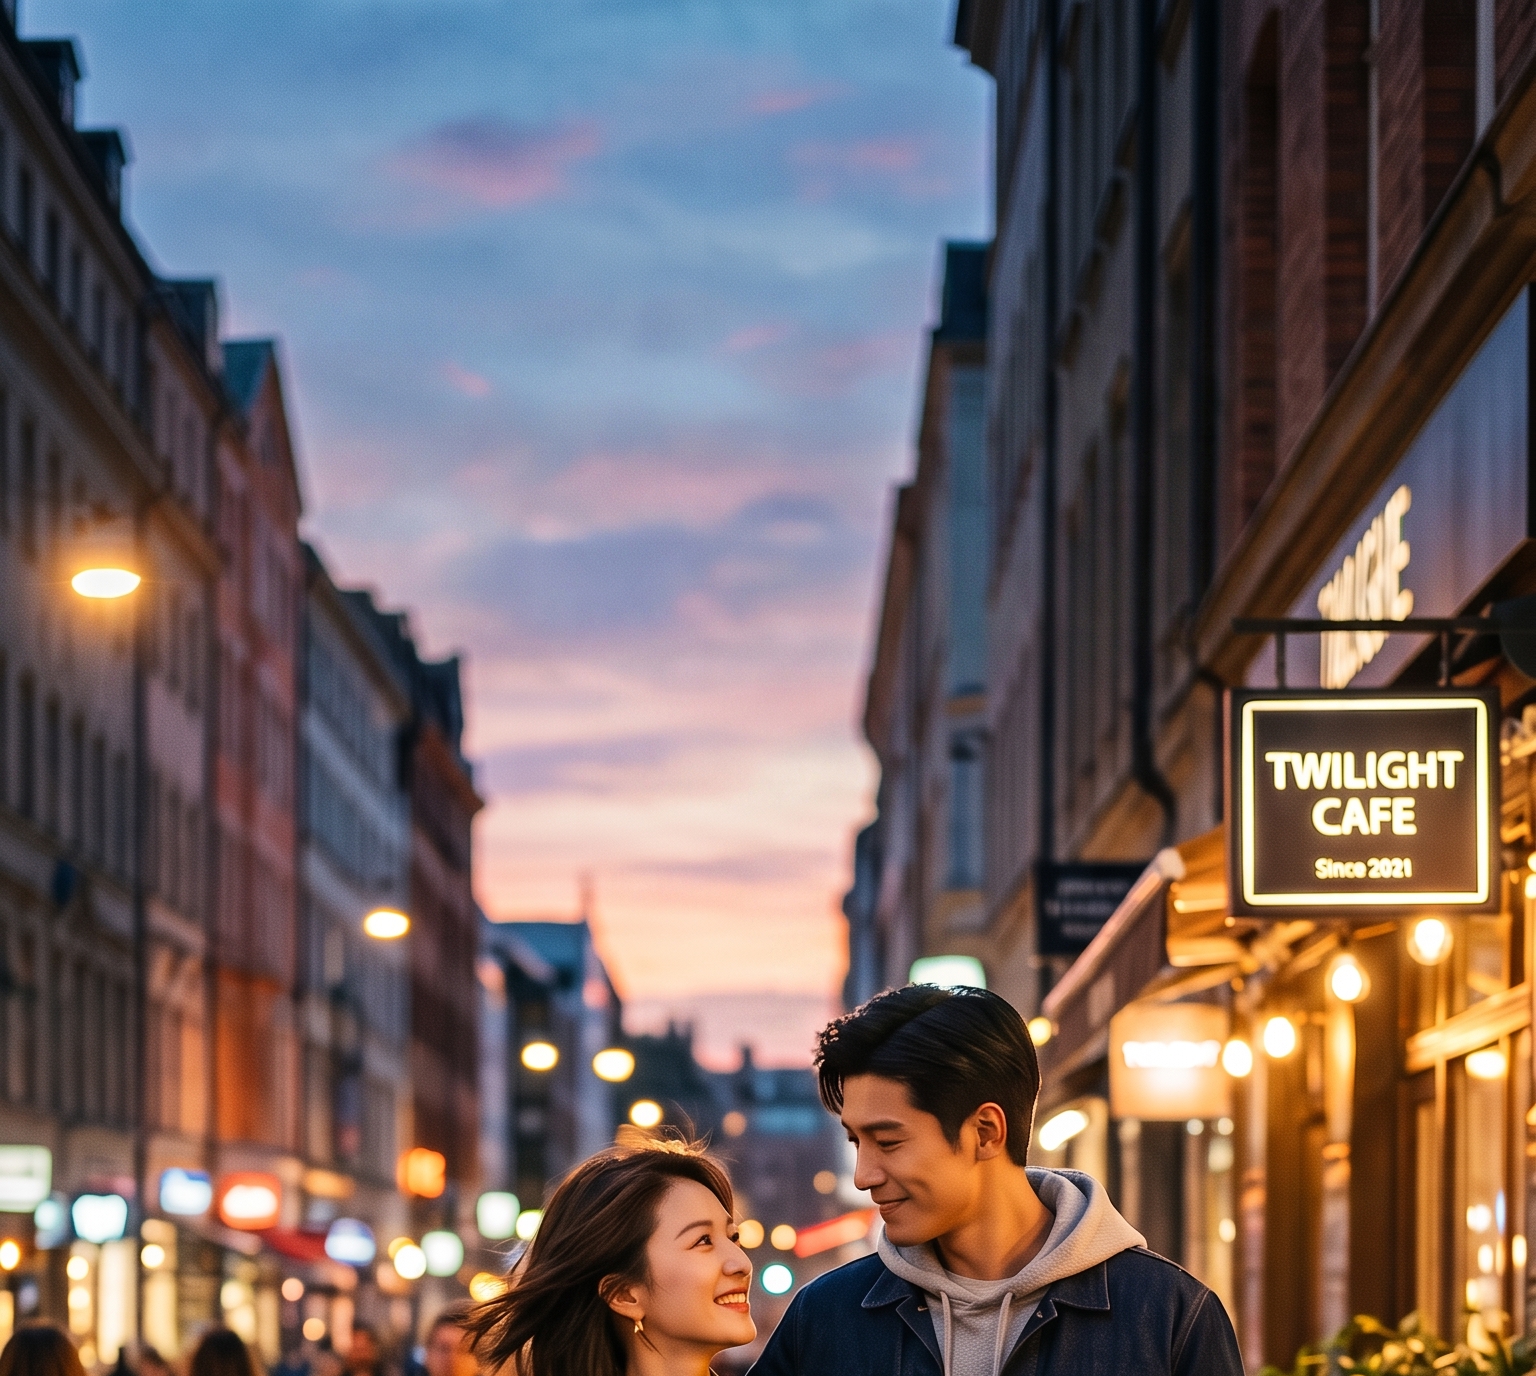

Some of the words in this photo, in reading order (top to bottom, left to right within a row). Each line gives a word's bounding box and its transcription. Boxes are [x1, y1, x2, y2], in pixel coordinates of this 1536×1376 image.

[1264, 750, 1465, 790] TWILIGHT
[1311, 796, 1418, 836] CAFE
[1314, 857, 1366, 879] Since
[1366, 857, 1413, 879] 2021
